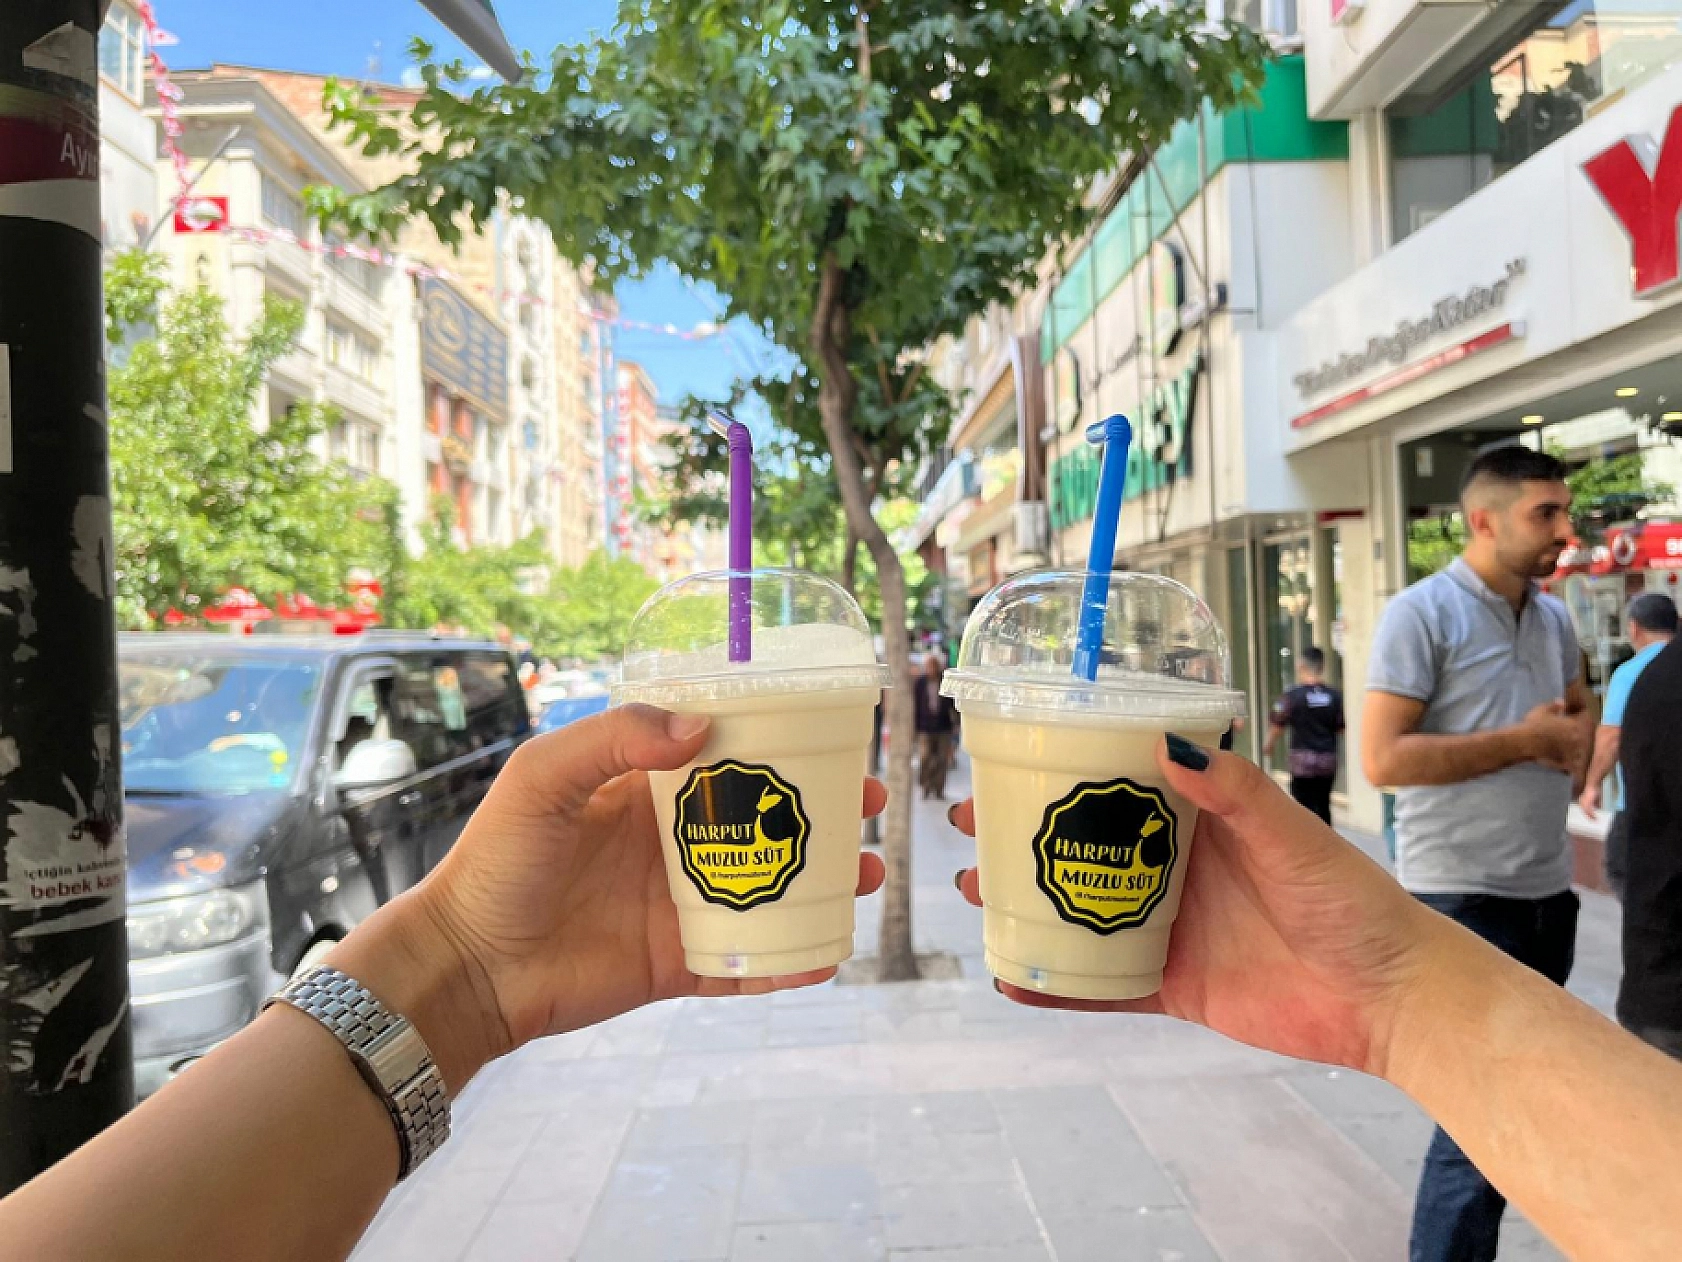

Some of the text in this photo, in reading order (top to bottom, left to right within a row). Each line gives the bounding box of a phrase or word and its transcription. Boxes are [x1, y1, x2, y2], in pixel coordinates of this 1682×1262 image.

[687, 823, 754, 840] HARPUT
[697, 846, 785, 867] MUZLU SÜT
[1054, 837, 1134, 862] HARPUT
[31, 879, 92, 899] bebek
[1061, 868, 1155, 891] MUZLU SÜT
